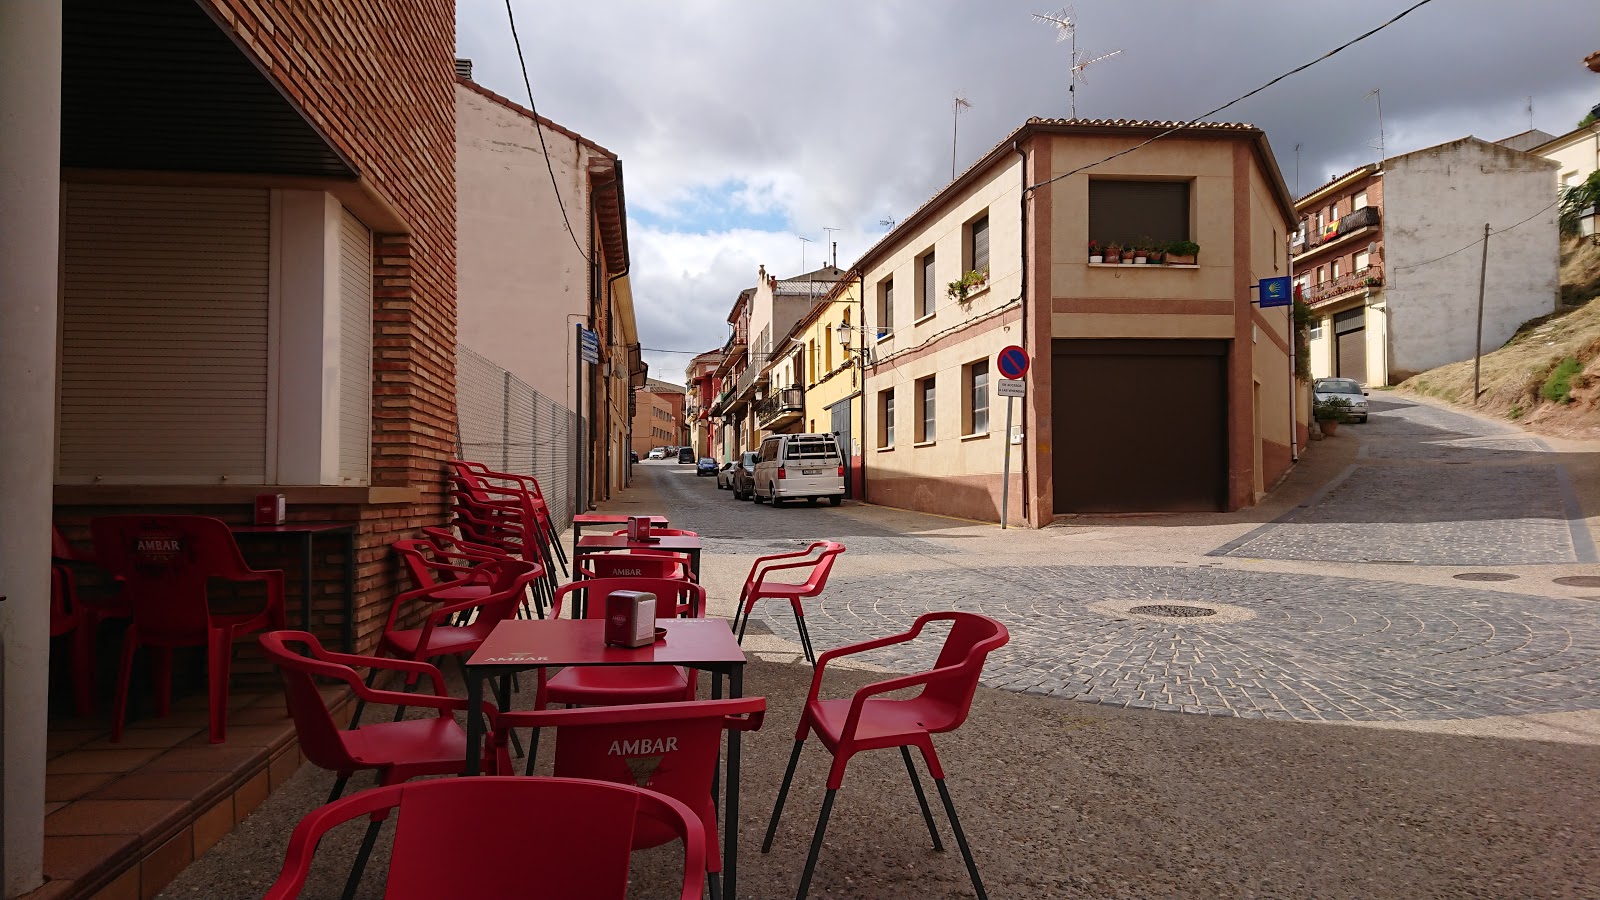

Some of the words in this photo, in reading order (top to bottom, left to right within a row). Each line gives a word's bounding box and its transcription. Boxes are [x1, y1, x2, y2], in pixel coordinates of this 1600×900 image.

[137, 540, 180, 551] AMBAR
[612, 568, 642, 576] AMBAR
[607, 736, 679, 756] AMBAR
